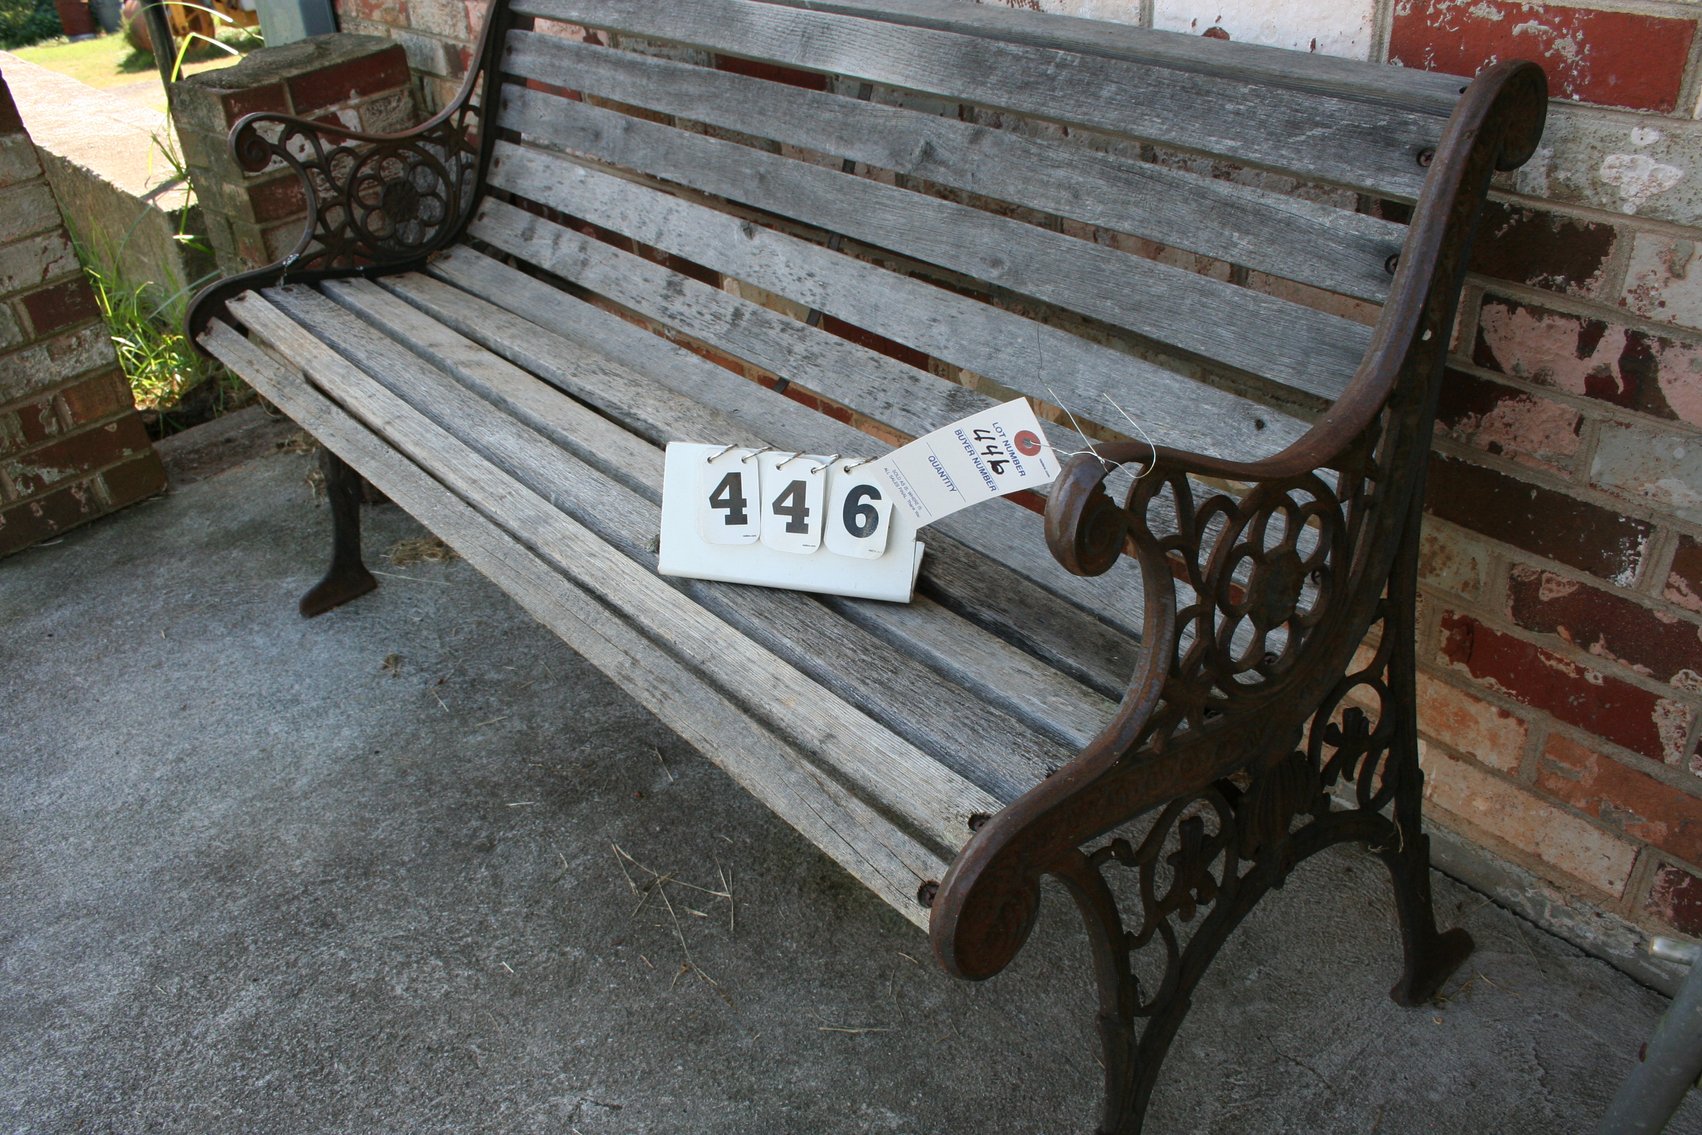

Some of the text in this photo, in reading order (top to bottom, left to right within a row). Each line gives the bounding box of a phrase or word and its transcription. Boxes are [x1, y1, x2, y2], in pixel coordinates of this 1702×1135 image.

[927, 455, 956, 493] QUANTITY
[954, 429, 997, 492] BUYER NUMBER
[971, 428, 1009, 475] 446
[992, 422, 1026, 477] LOT NUMBER
